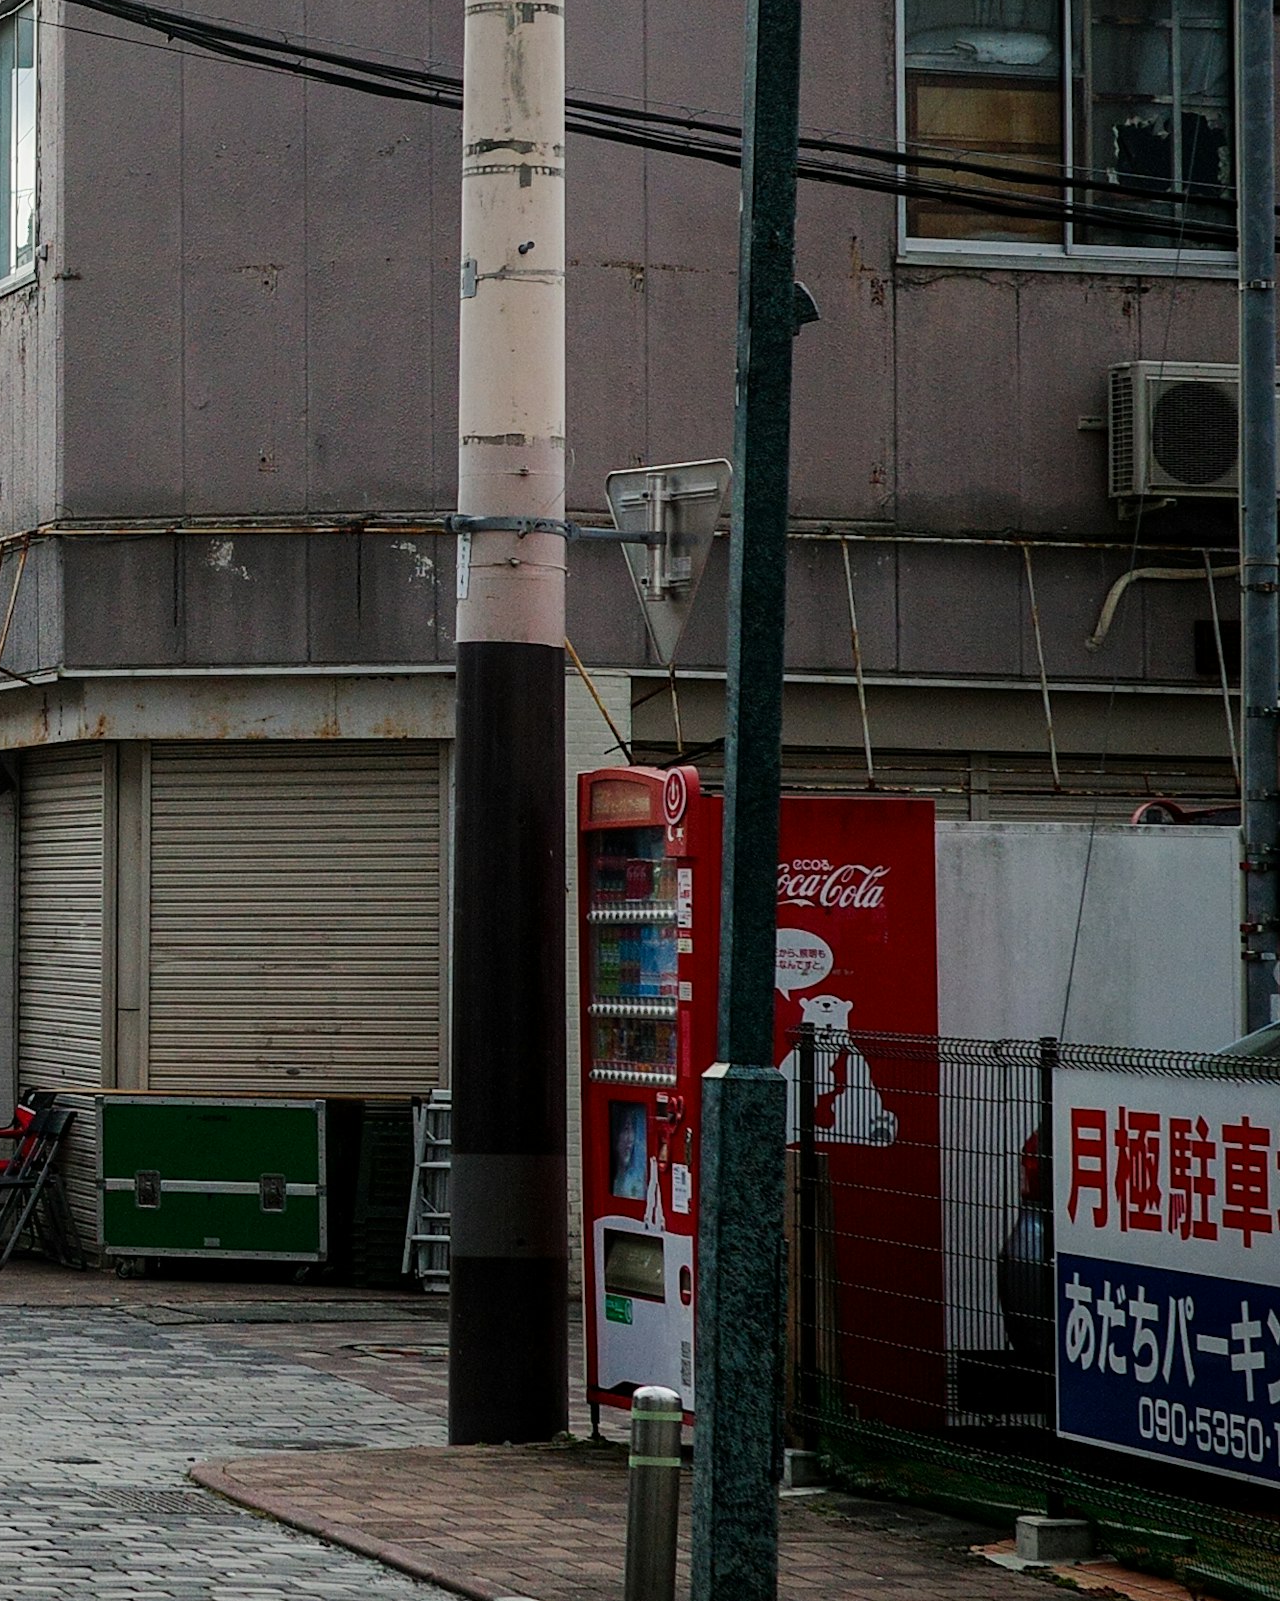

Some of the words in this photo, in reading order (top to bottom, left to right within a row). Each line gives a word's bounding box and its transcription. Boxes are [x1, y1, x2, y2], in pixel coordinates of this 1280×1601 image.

[776, 960, 824, 970] なんですと。
[1066, 1106, 1280, 1249] 月極駐車
